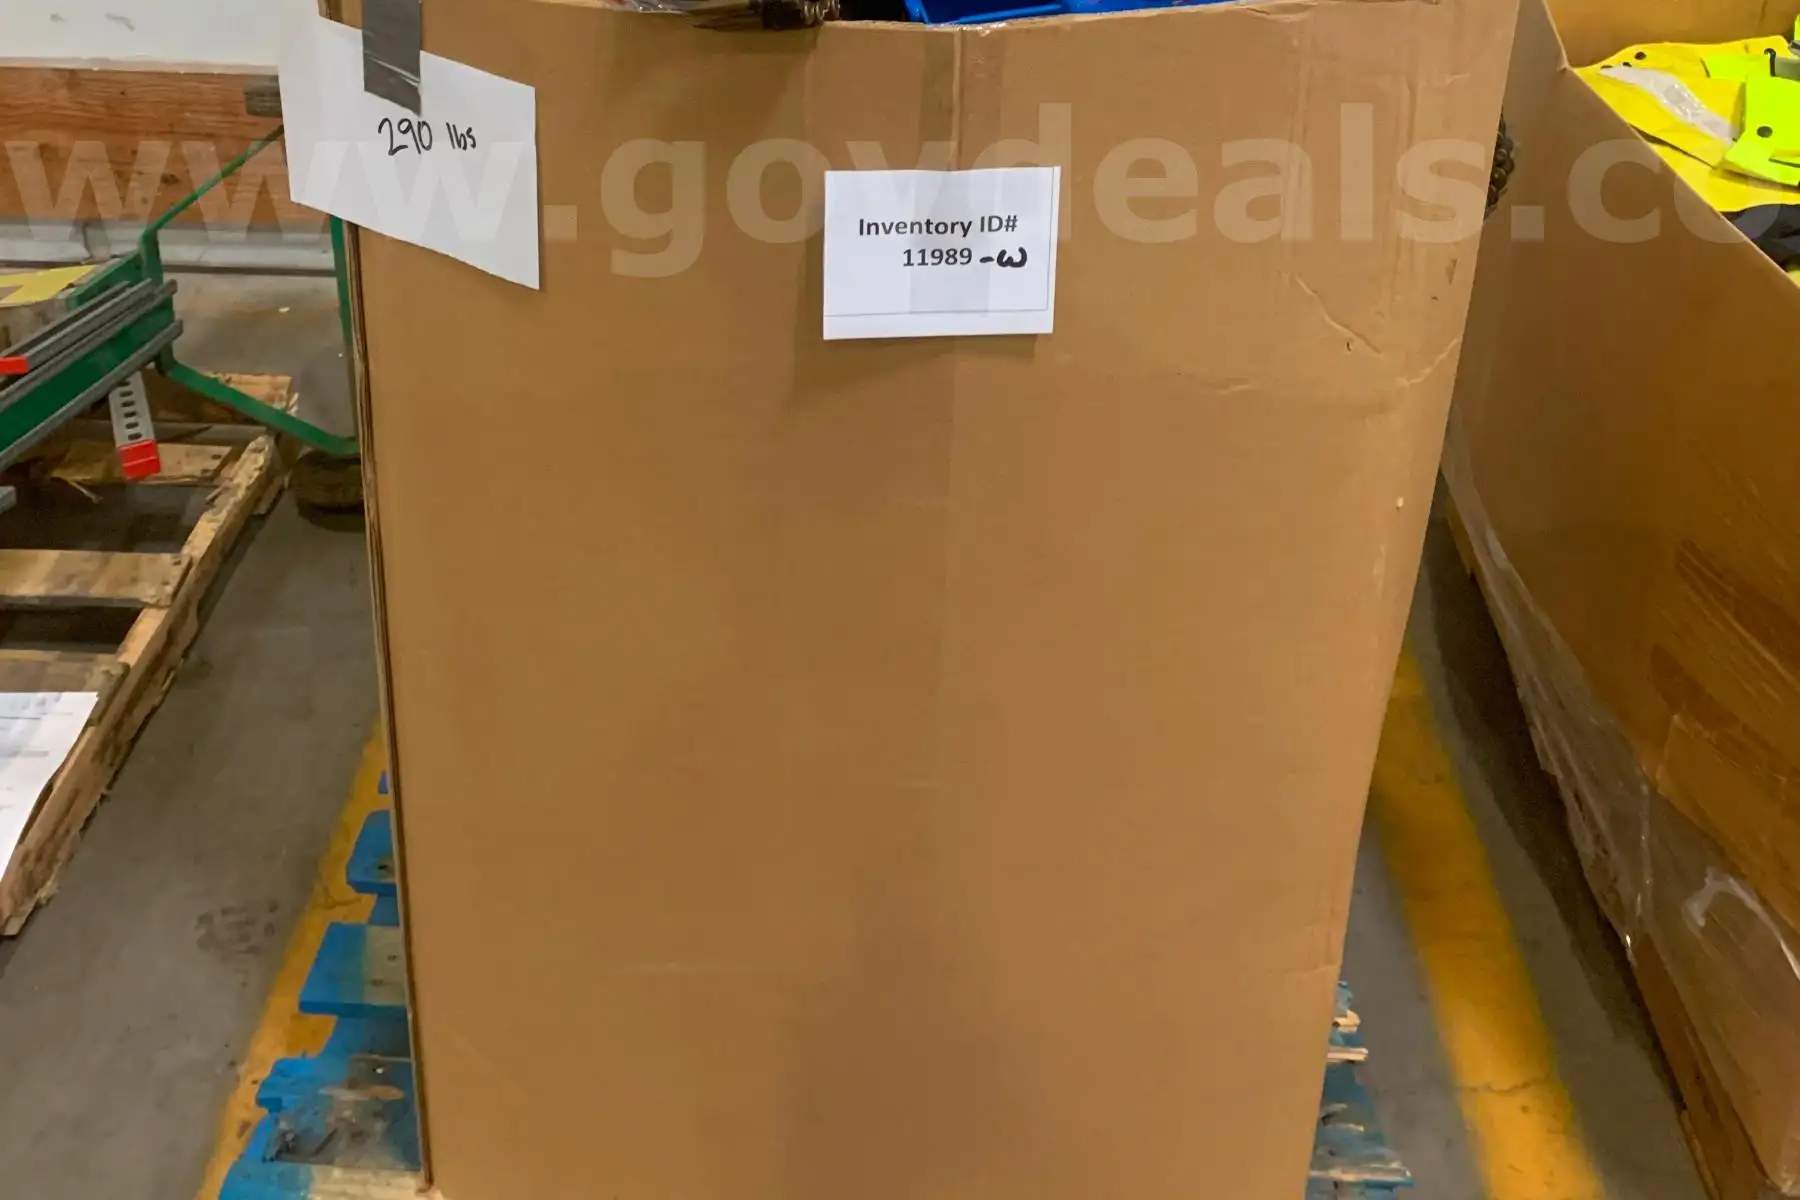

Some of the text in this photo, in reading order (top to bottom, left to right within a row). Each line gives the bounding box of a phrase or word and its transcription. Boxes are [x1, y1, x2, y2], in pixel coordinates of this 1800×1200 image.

[377, 117, 477, 156] 290 lbs
[859, 215, 1018, 238] Inventory ID#
[903, 247, 973, 267] 11989
